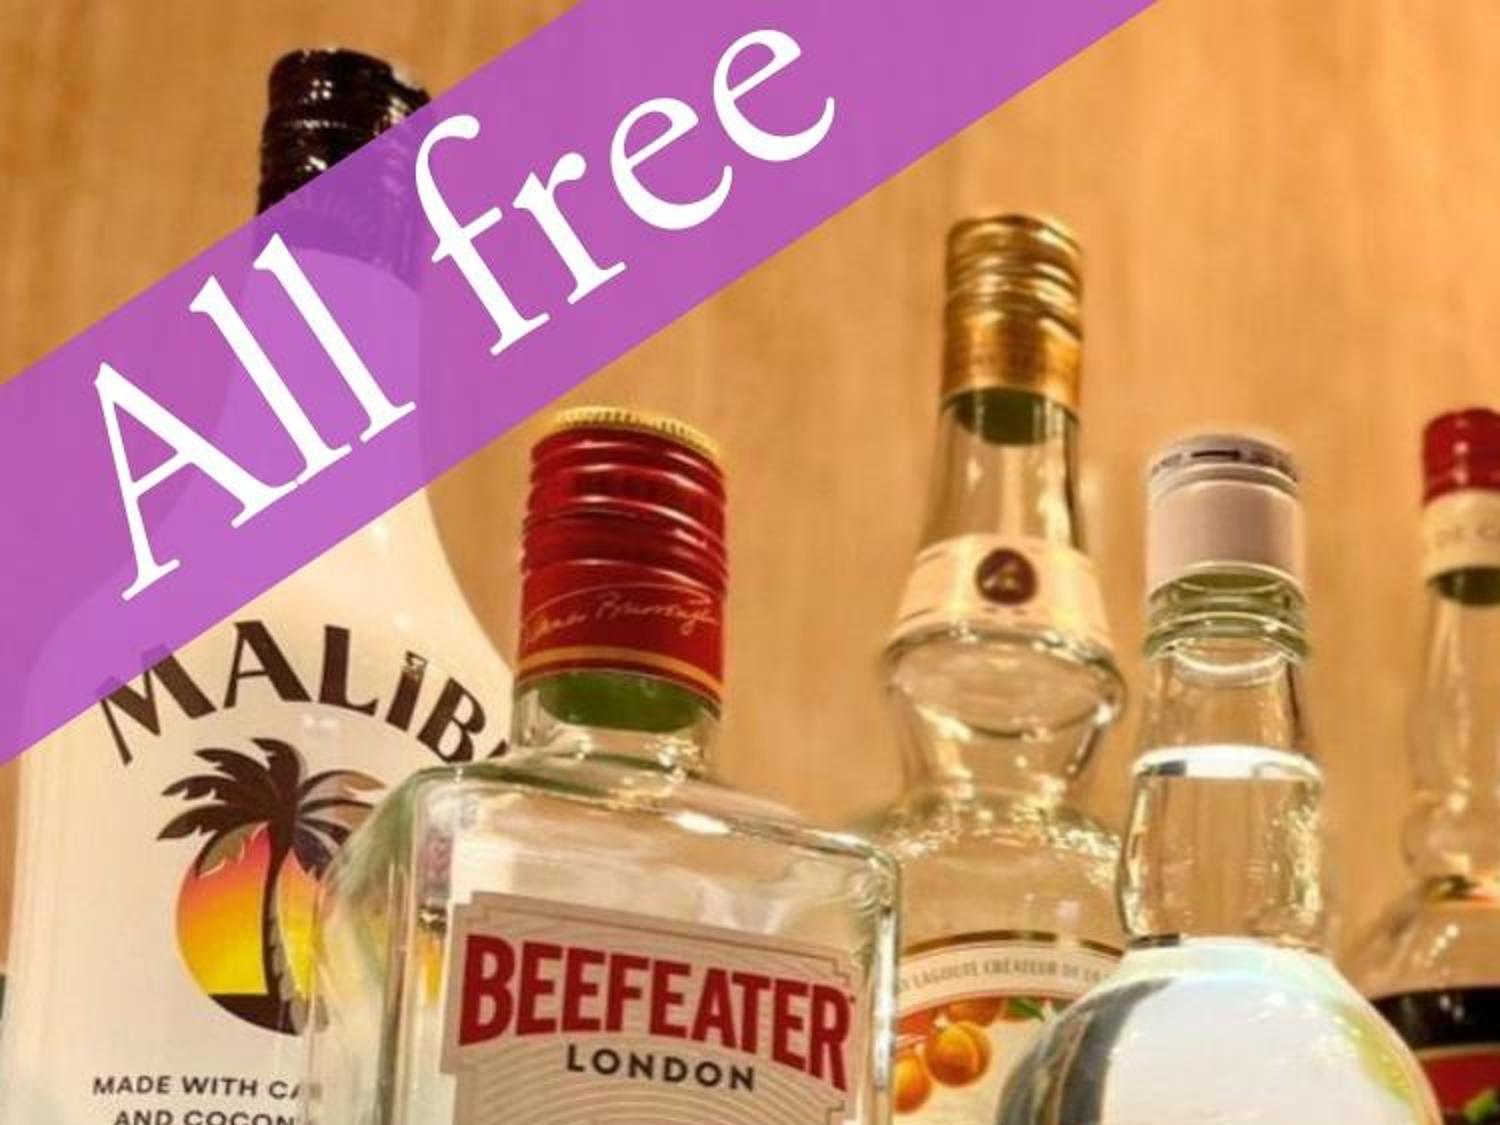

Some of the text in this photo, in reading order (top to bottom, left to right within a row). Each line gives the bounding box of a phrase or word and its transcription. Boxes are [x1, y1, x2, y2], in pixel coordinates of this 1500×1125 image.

[98, 619, 508, 767] MALIB
[458, 933, 852, 1093] BEEFEATER
[92, 1075, 171, 1097] MADE
[182, 1077, 258, 1098] WITH
[566, 1043, 755, 1093] LONDON
